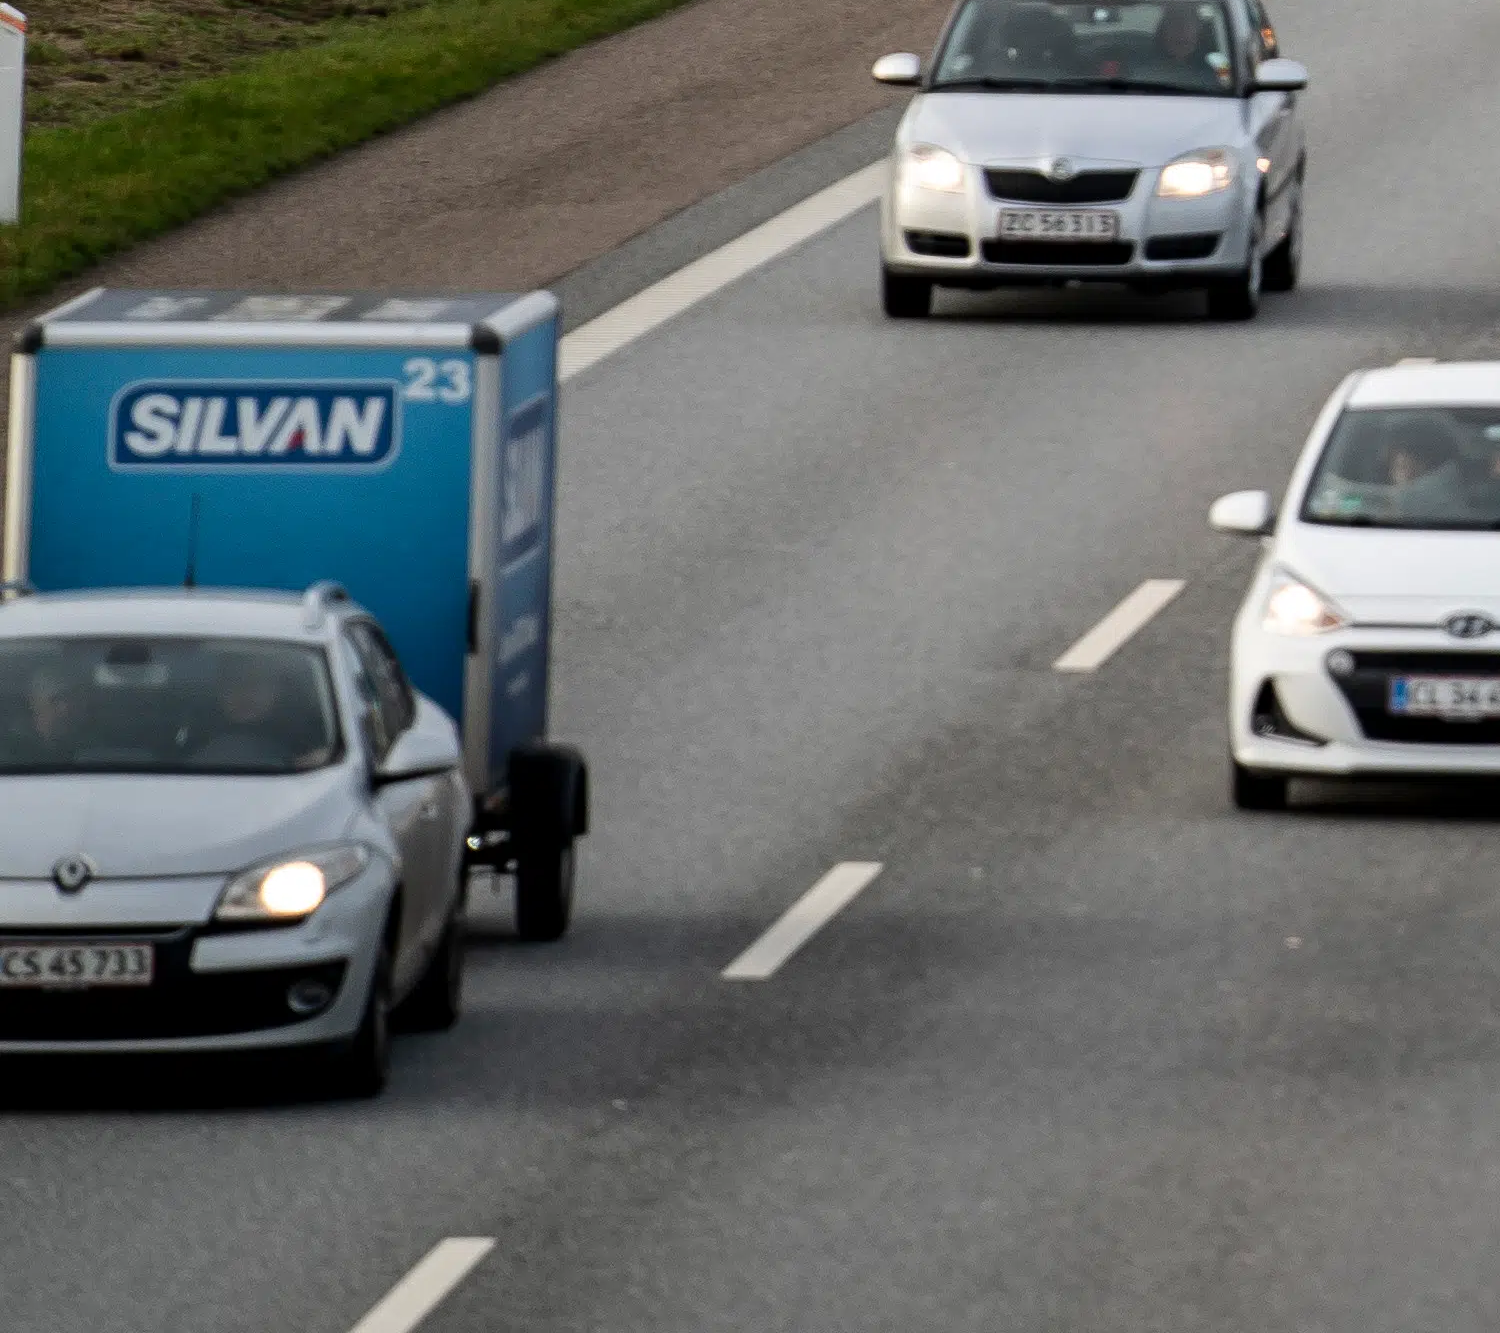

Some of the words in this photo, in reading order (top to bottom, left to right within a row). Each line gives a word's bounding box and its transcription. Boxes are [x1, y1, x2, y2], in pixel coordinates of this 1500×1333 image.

[400, 356, 473, 406] 23
[123, 392, 387, 457] SILVAN
[3, 950, 42, 976] CS
[49, 949, 85, 976] 45
